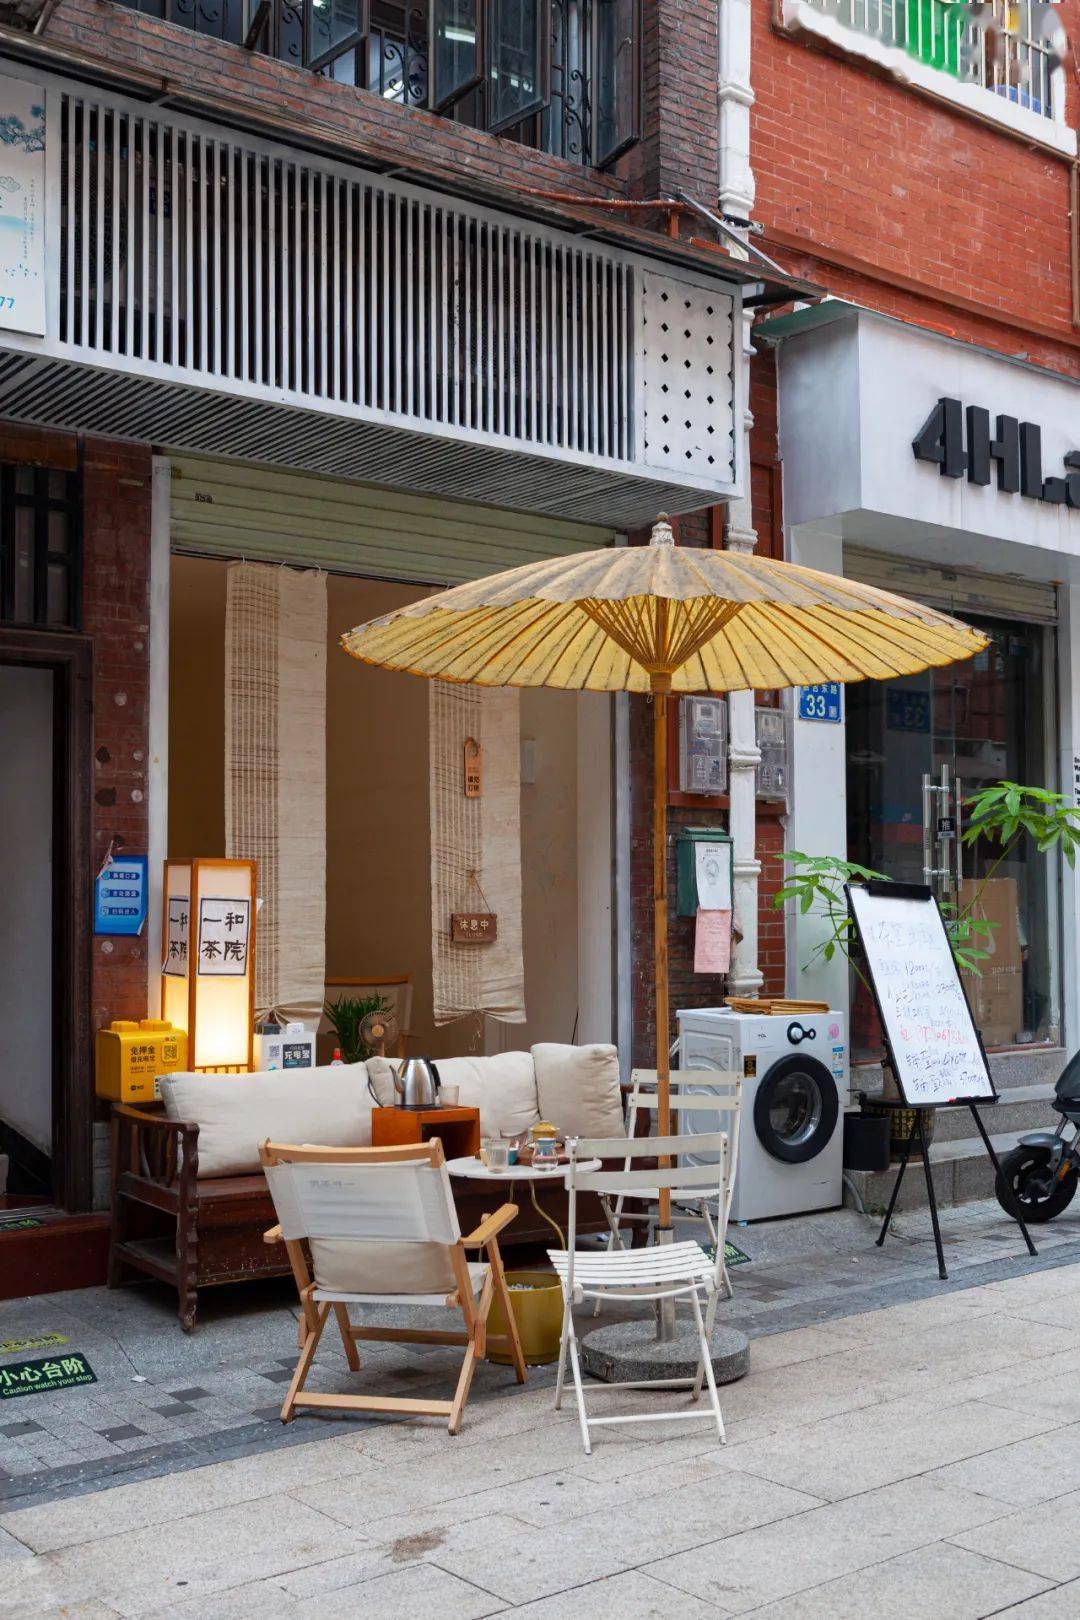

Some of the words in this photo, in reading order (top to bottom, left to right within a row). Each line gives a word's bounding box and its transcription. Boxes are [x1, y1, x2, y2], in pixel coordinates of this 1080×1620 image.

[806, 694, 826, 717] 33
[203, 912, 244, 932] 一和
[460, 919, 489, 931] 休息中
[201, 940, 246, 961] 茶院
[130, 1045, 155, 1055] 免押金
[0, 1358, 86, 1386] 小心台阶
[2, 1384, 34, 1395] Caution
[35, 1379, 57, 1390] watch
[58, 1377, 75, 1388] your
[76, 1374, 93, 1383] step
